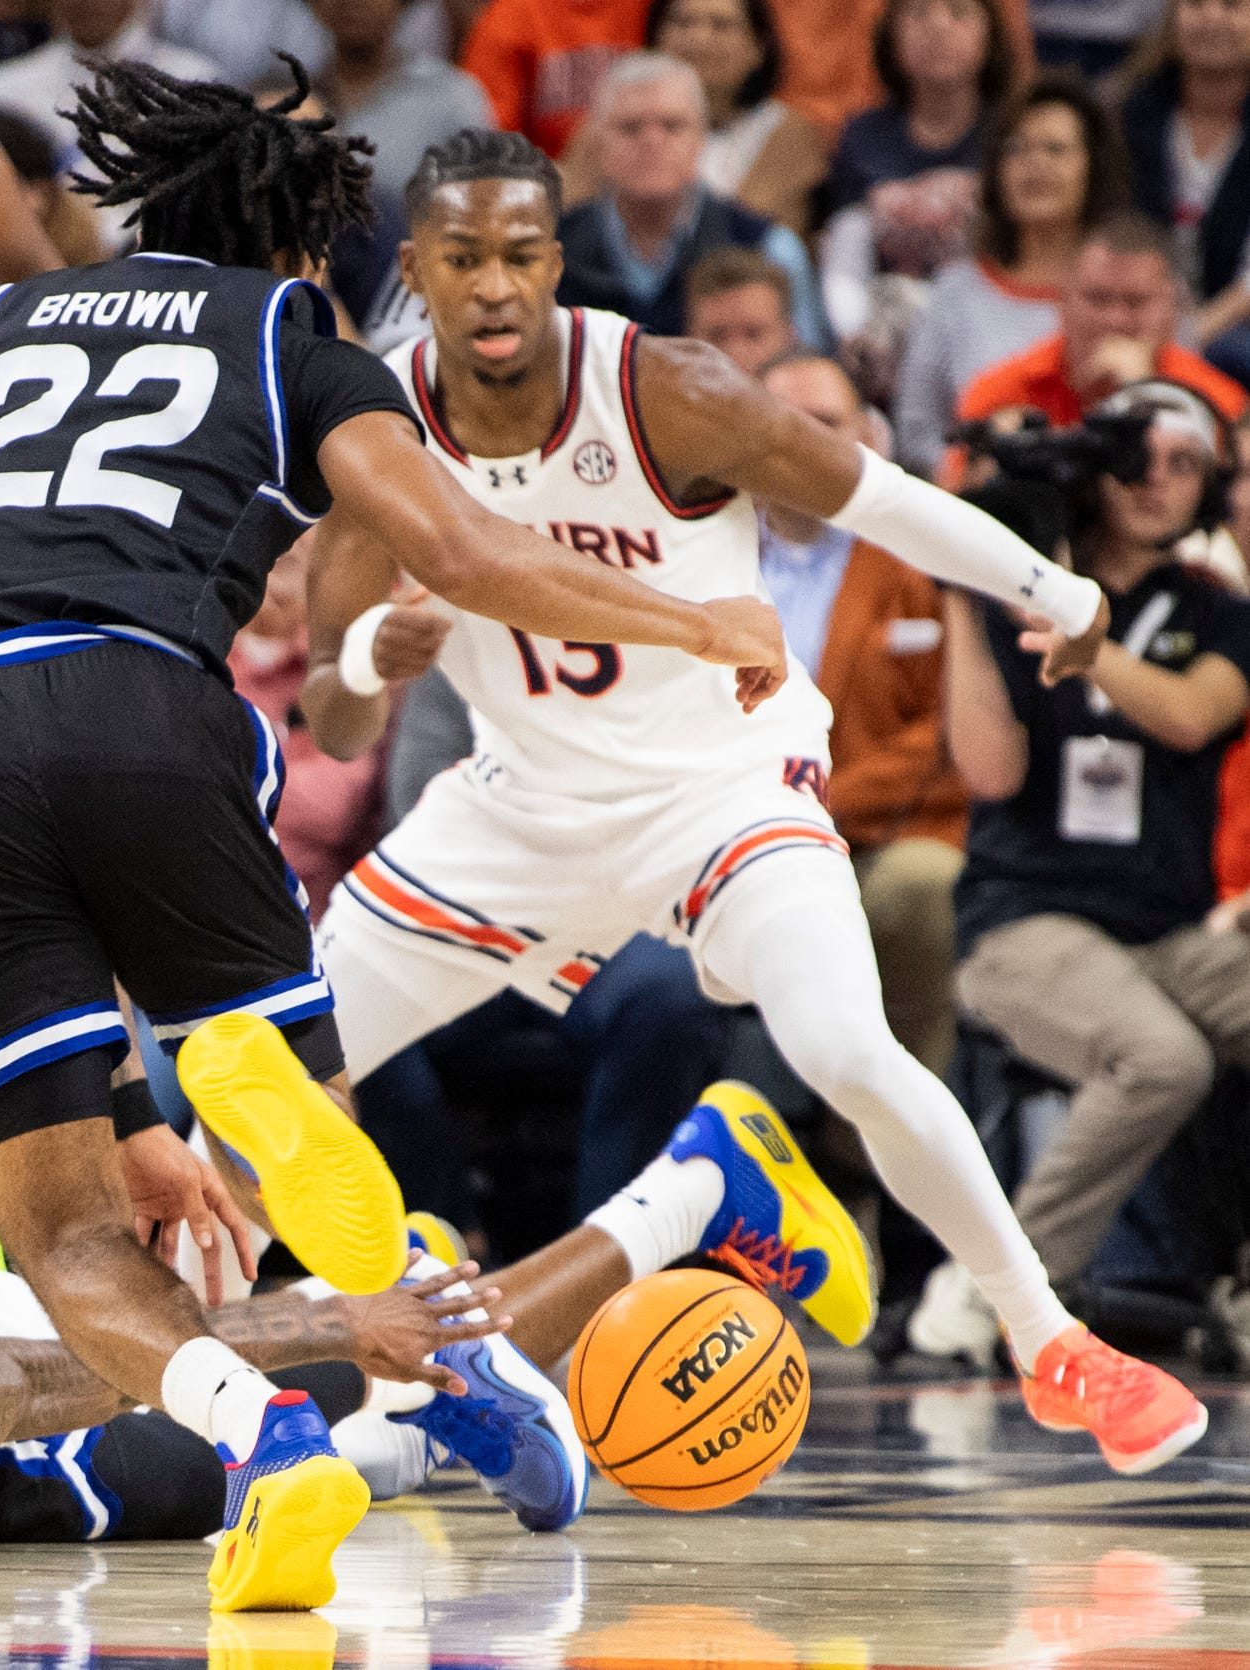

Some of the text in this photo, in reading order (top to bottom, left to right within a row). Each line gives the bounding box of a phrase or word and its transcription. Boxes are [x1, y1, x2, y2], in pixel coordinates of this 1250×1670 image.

[27, 290, 208, 334] BROWN
[660, 1311, 757, 1403] NCAA
[686, 1353, 804, 1465] Wilson
